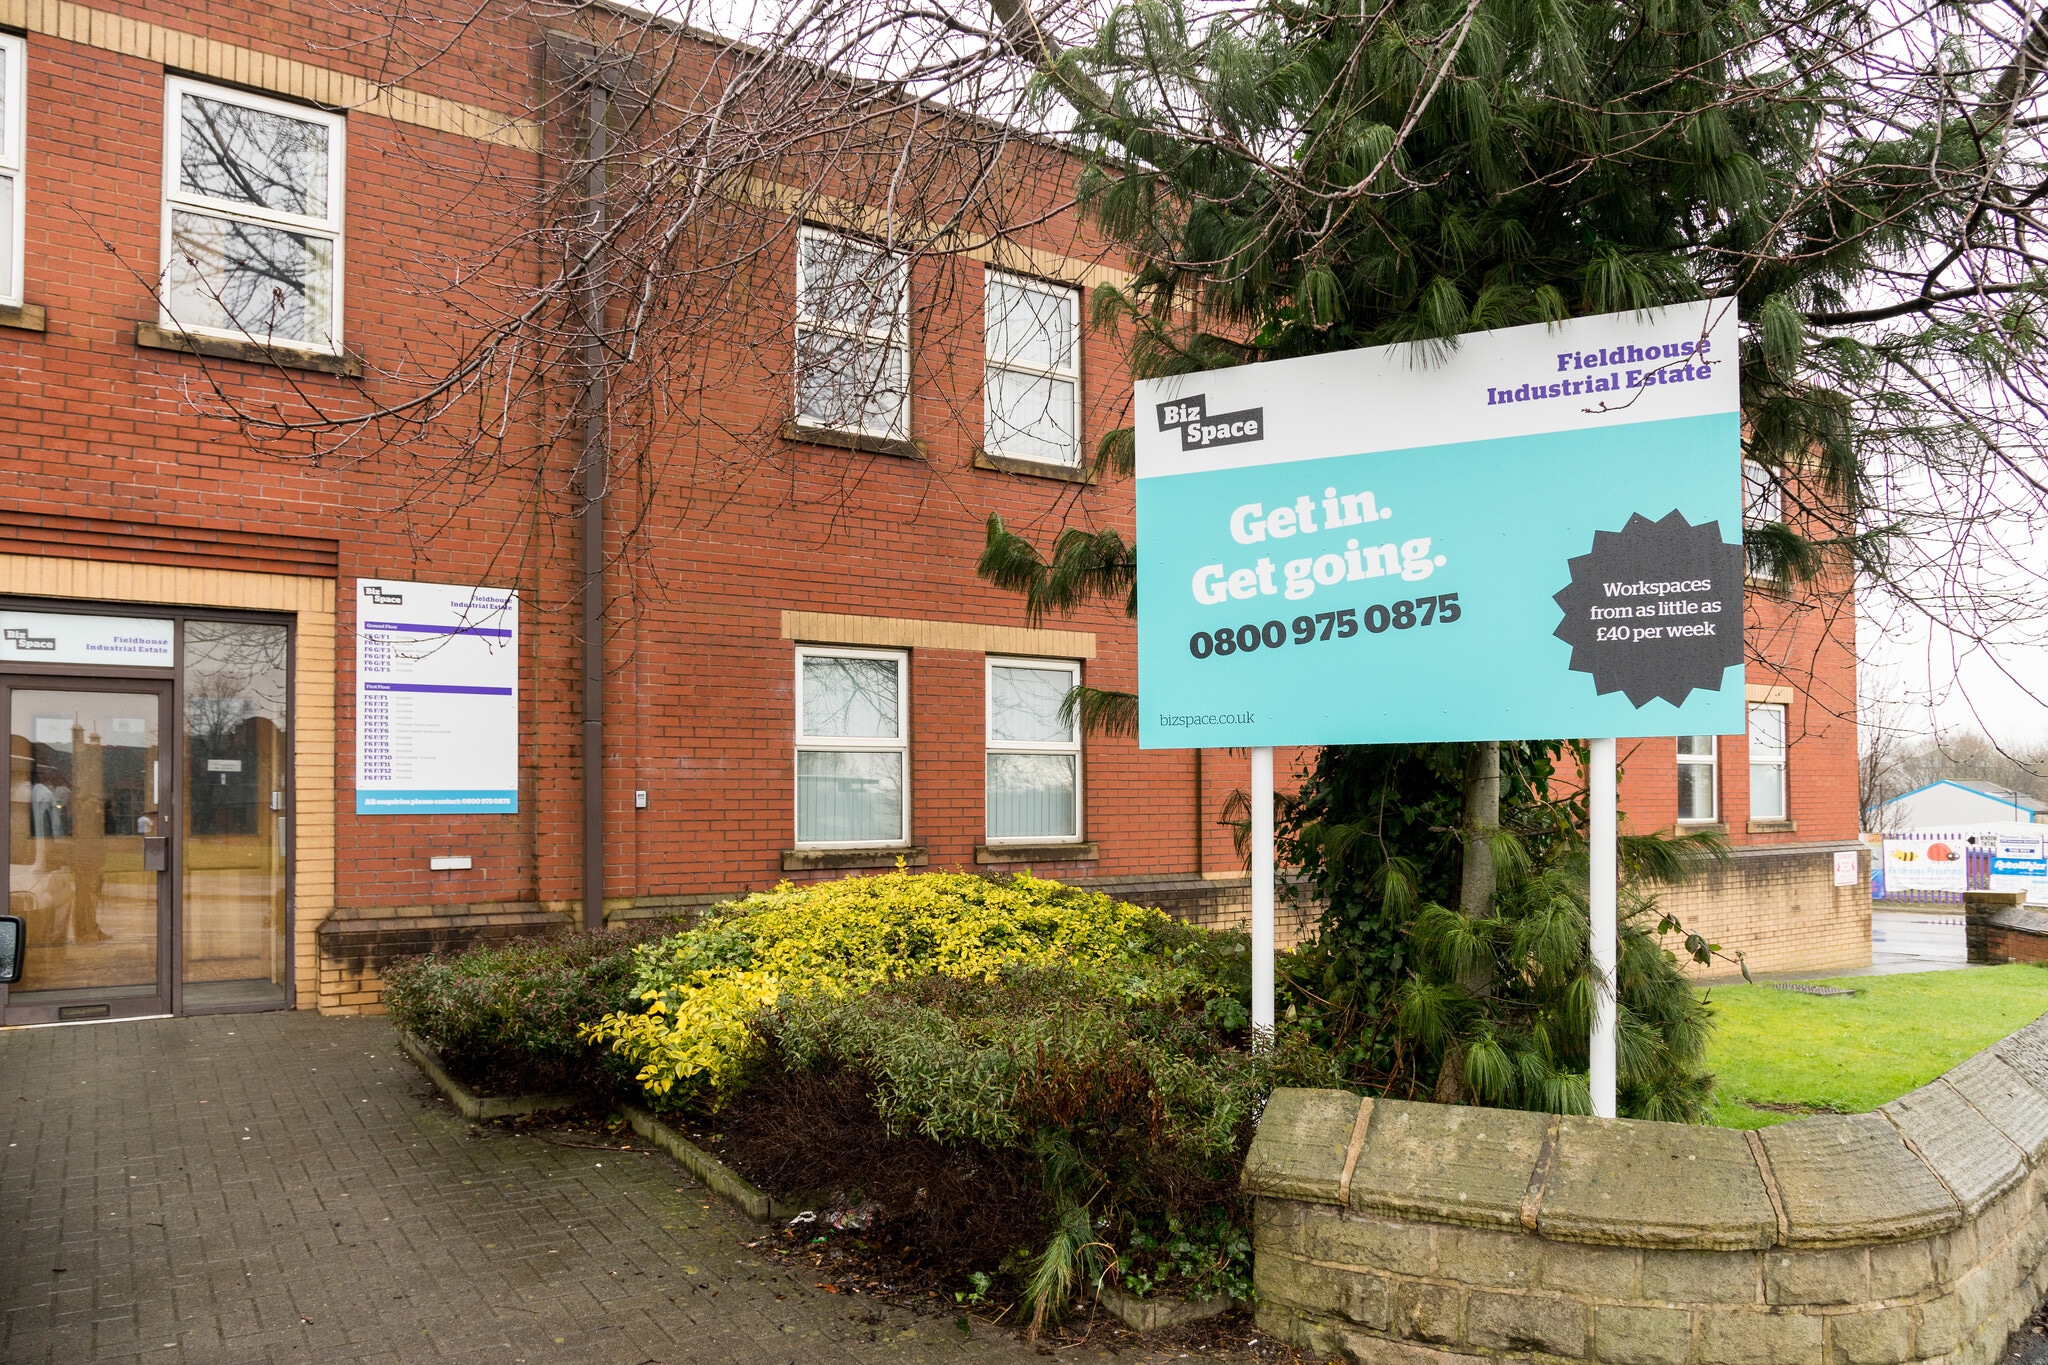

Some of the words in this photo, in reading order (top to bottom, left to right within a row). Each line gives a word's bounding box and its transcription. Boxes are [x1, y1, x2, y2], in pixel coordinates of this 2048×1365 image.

[1557, 339, 1711, 372] Fieldhouse
[1487, 372, 1620, 406] Industrial
[1625, 364, 1712, 389] Estate
[1163, 403, 1201, 425] Biz
[1187, 419, 1258, 445] Space
[1229, 495, 1318, 545] Get
[1322, 486, 1393, 530] in.
[1191, 557, 1278, 606] Get
[1283, 537, 1447, 601] going.
[365, 587, 381, 595] Biz
[1603, 579, 1711, 597] Workspaces
[374, 595, 401, 604] Space
[450, 601, 489, 610] Industrial
[1590, 605, 1633, 620] from
[1636, 604, 1656, 617] as
[1658, 600, 1698, 616] little
[1701, 601, 1722, 614] as
[6, 630, 27, 639] Biz
[1189, 620, 1287, 660] 0800
[1291, 608, 1359, 646] 975
[1363, 592, 1462, 634] 0875
[1596, 625, 1630, 642] £40
[1632, 626, 1663, 643] per
[1666, 621, 1716, 638] week
[18, 639, 54, 649] Space
[86, 643, 136, 653] Industrial
[138, 646, 168, 654] Estate
[113, 636, 168, 646] Fieldhouse
[1160, 711, 1255, 728] bizspace.co.uk
[376, 798, 410, 807] enquiries
[410, 798, 433, 806] please
